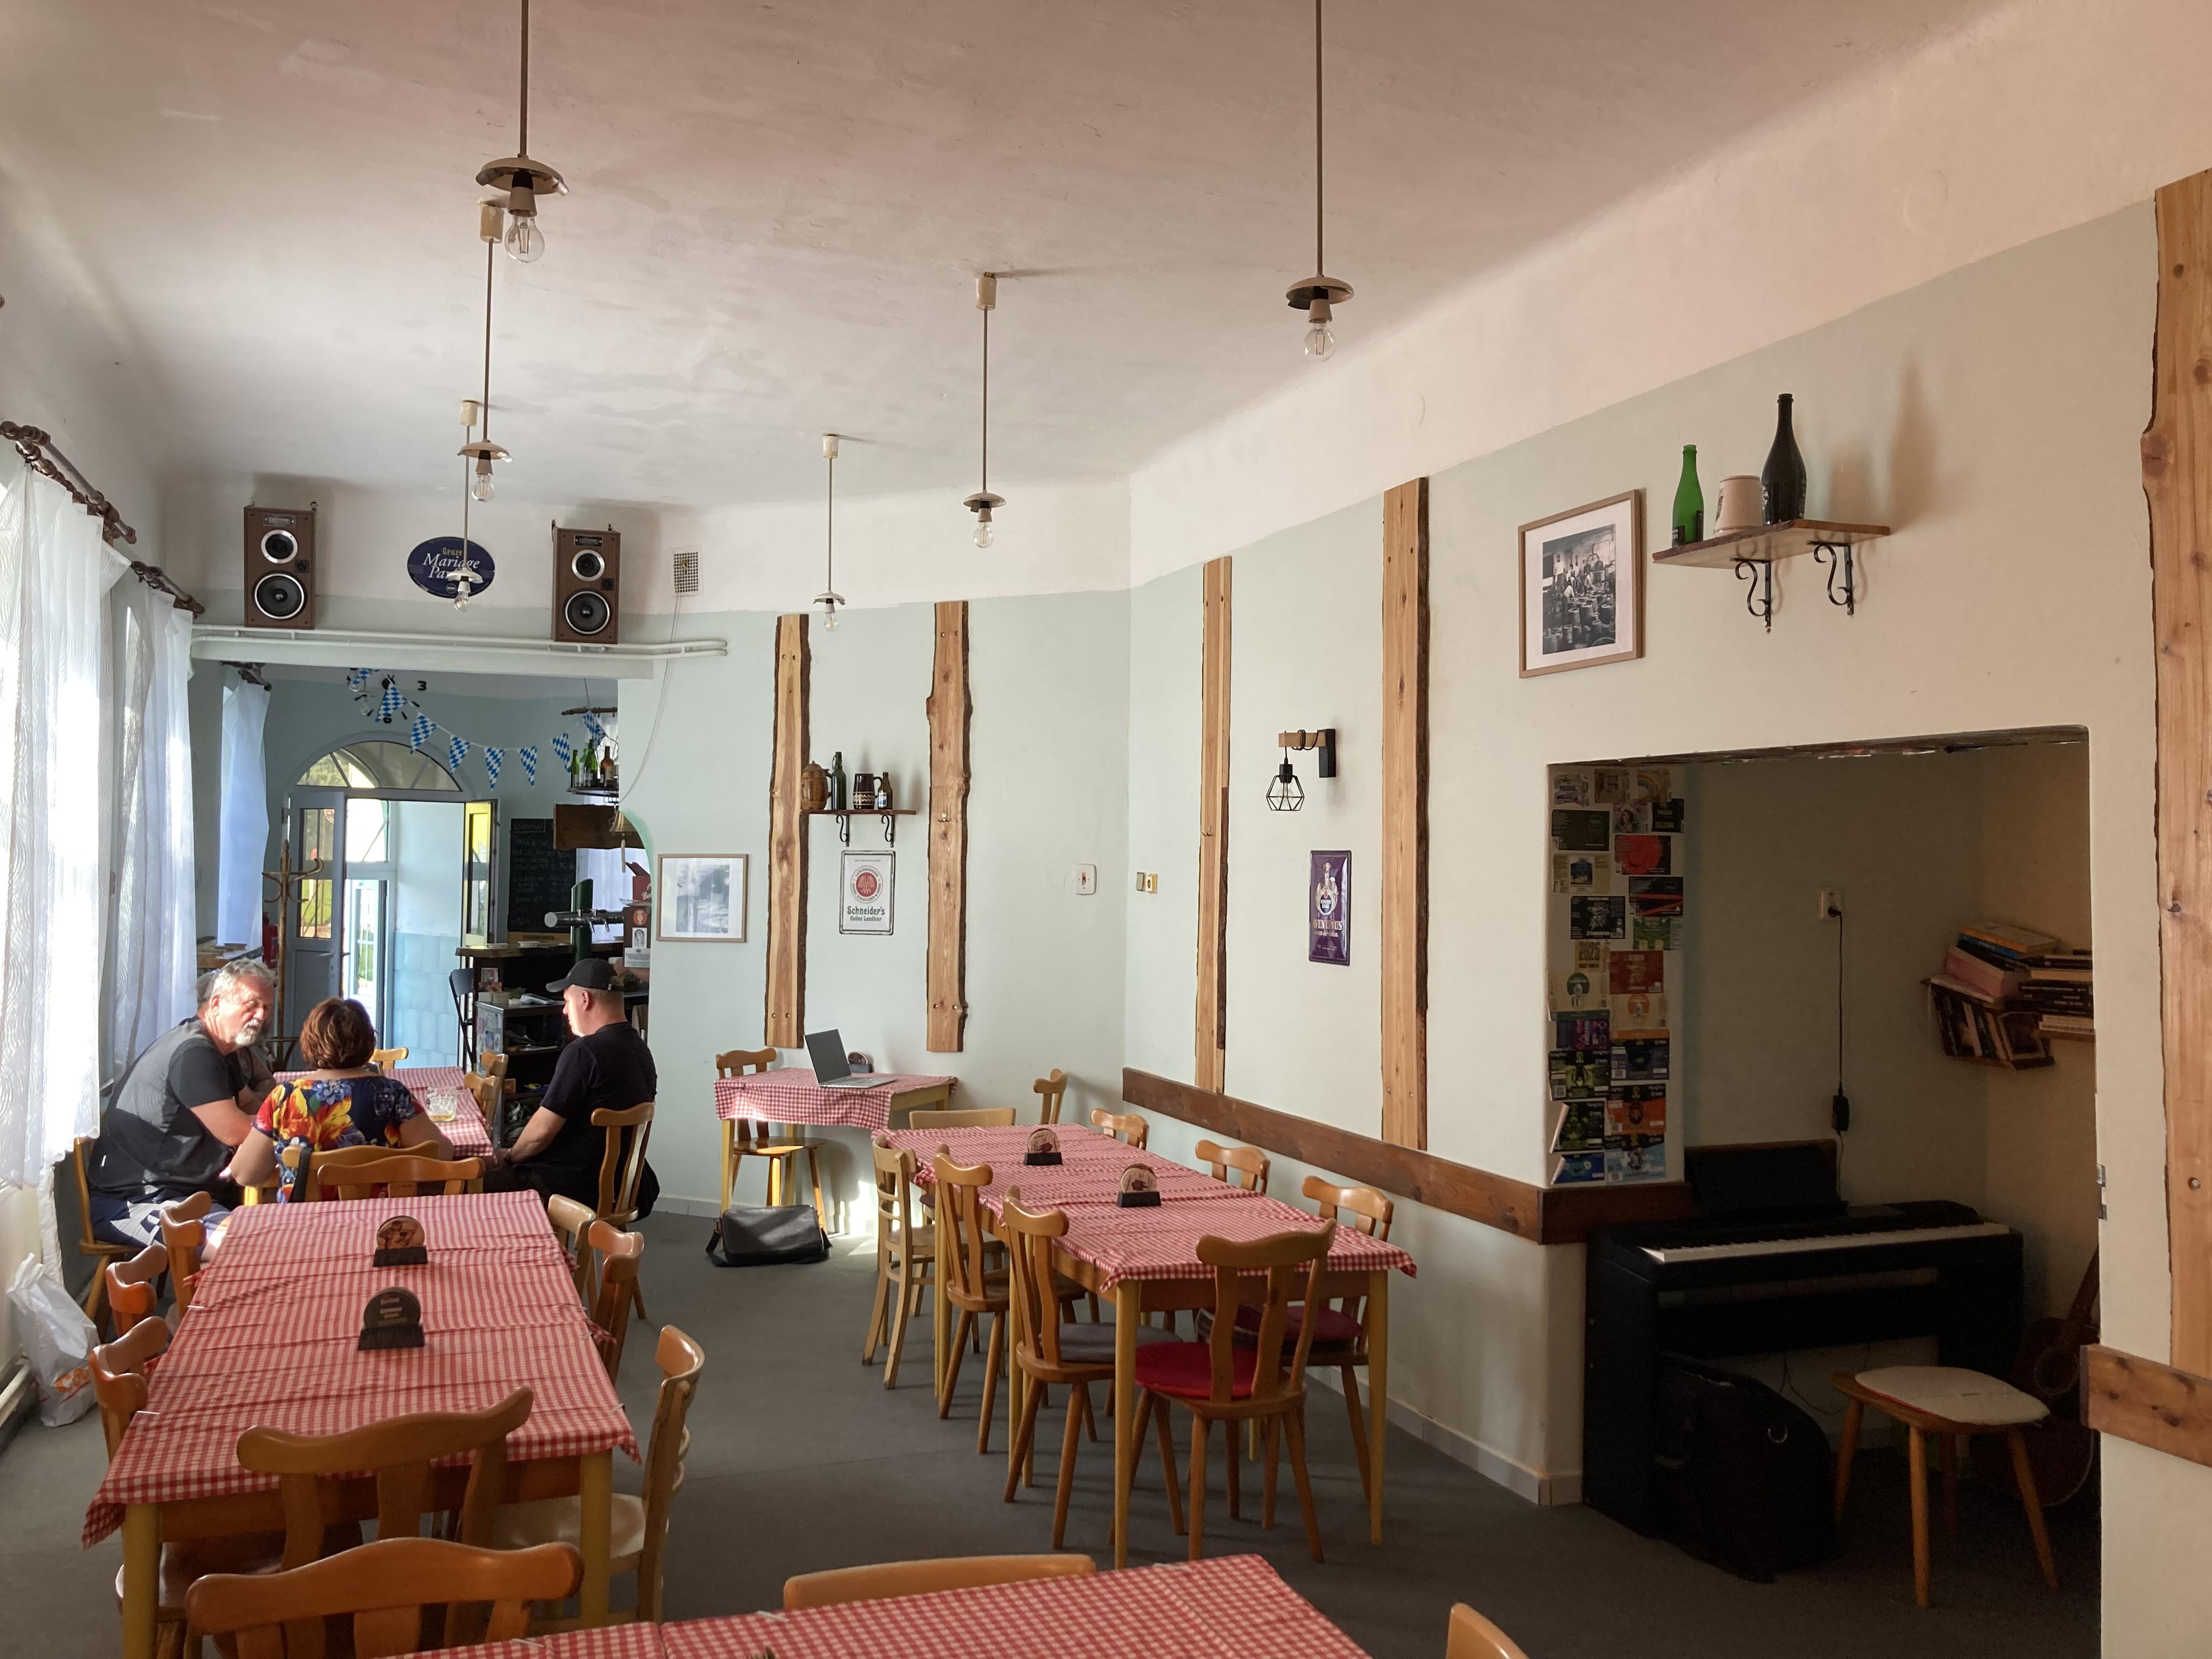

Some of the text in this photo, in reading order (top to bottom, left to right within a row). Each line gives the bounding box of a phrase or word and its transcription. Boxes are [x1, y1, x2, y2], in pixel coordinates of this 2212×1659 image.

[442, 547, 463, 556] Geuze
[418, 680, 427, 691] 3
[847, 906, 885, 915] Schneider's
